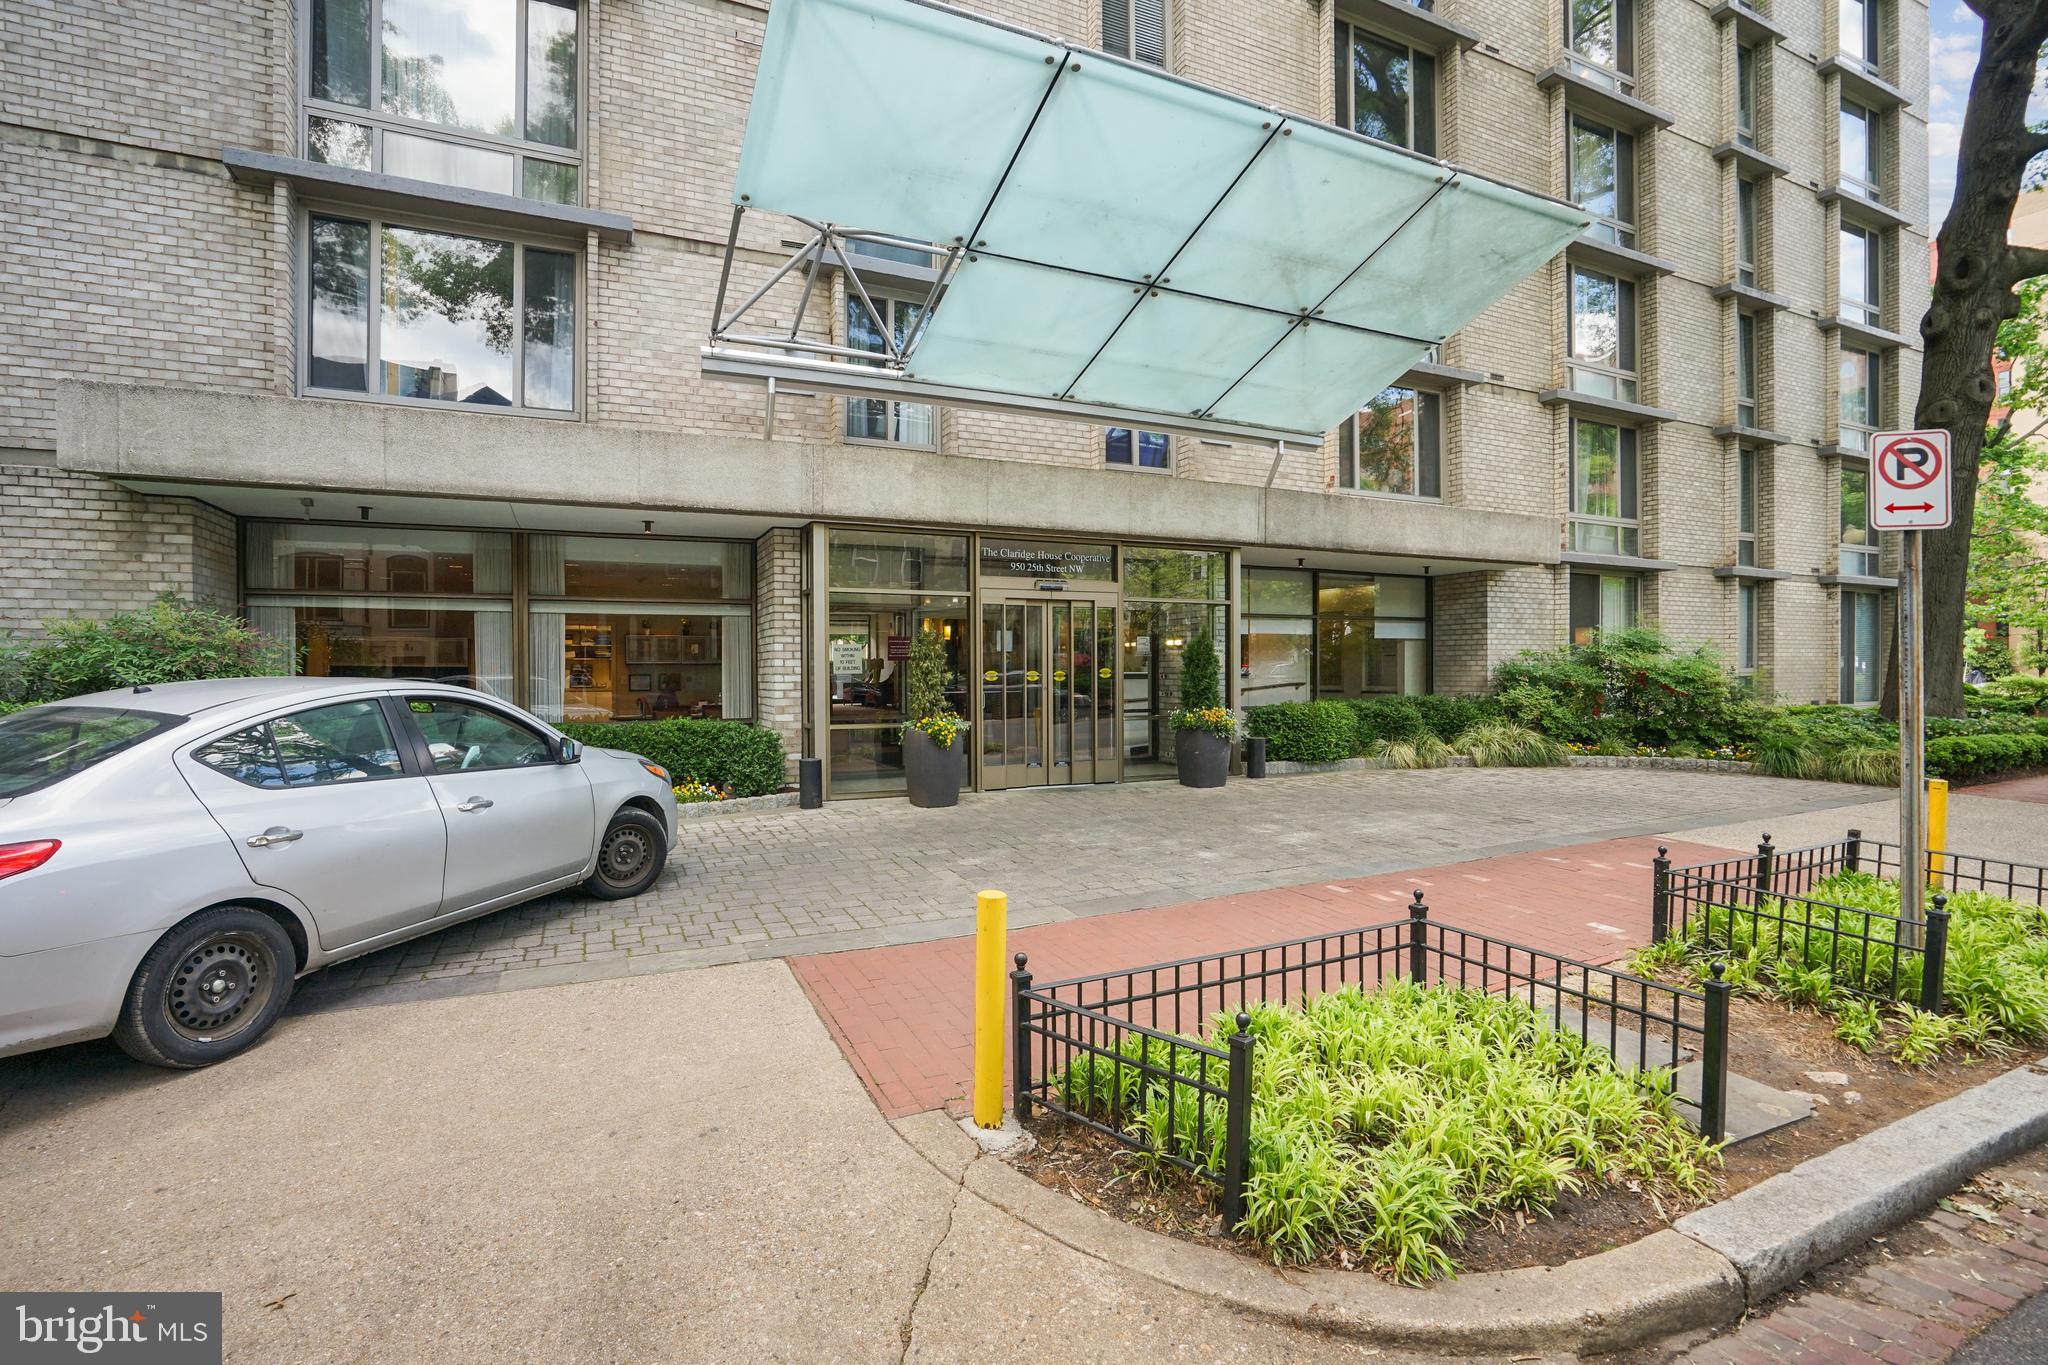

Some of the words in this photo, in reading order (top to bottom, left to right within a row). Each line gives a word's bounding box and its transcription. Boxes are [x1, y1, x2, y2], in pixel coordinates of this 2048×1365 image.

[982, 547, 998, 557] The
[1000, 548, 1035, 561] Claridge
[1037, 551, 1063, 560] House
[1065, 552, 1111, 563] Cooperative
[1010, 562, 1025, 571] 950
[1027, 562, 1044, 572] 25th
[1046, 563, 1067, 573] Street
[1069, 565, 1084, 573] NW
